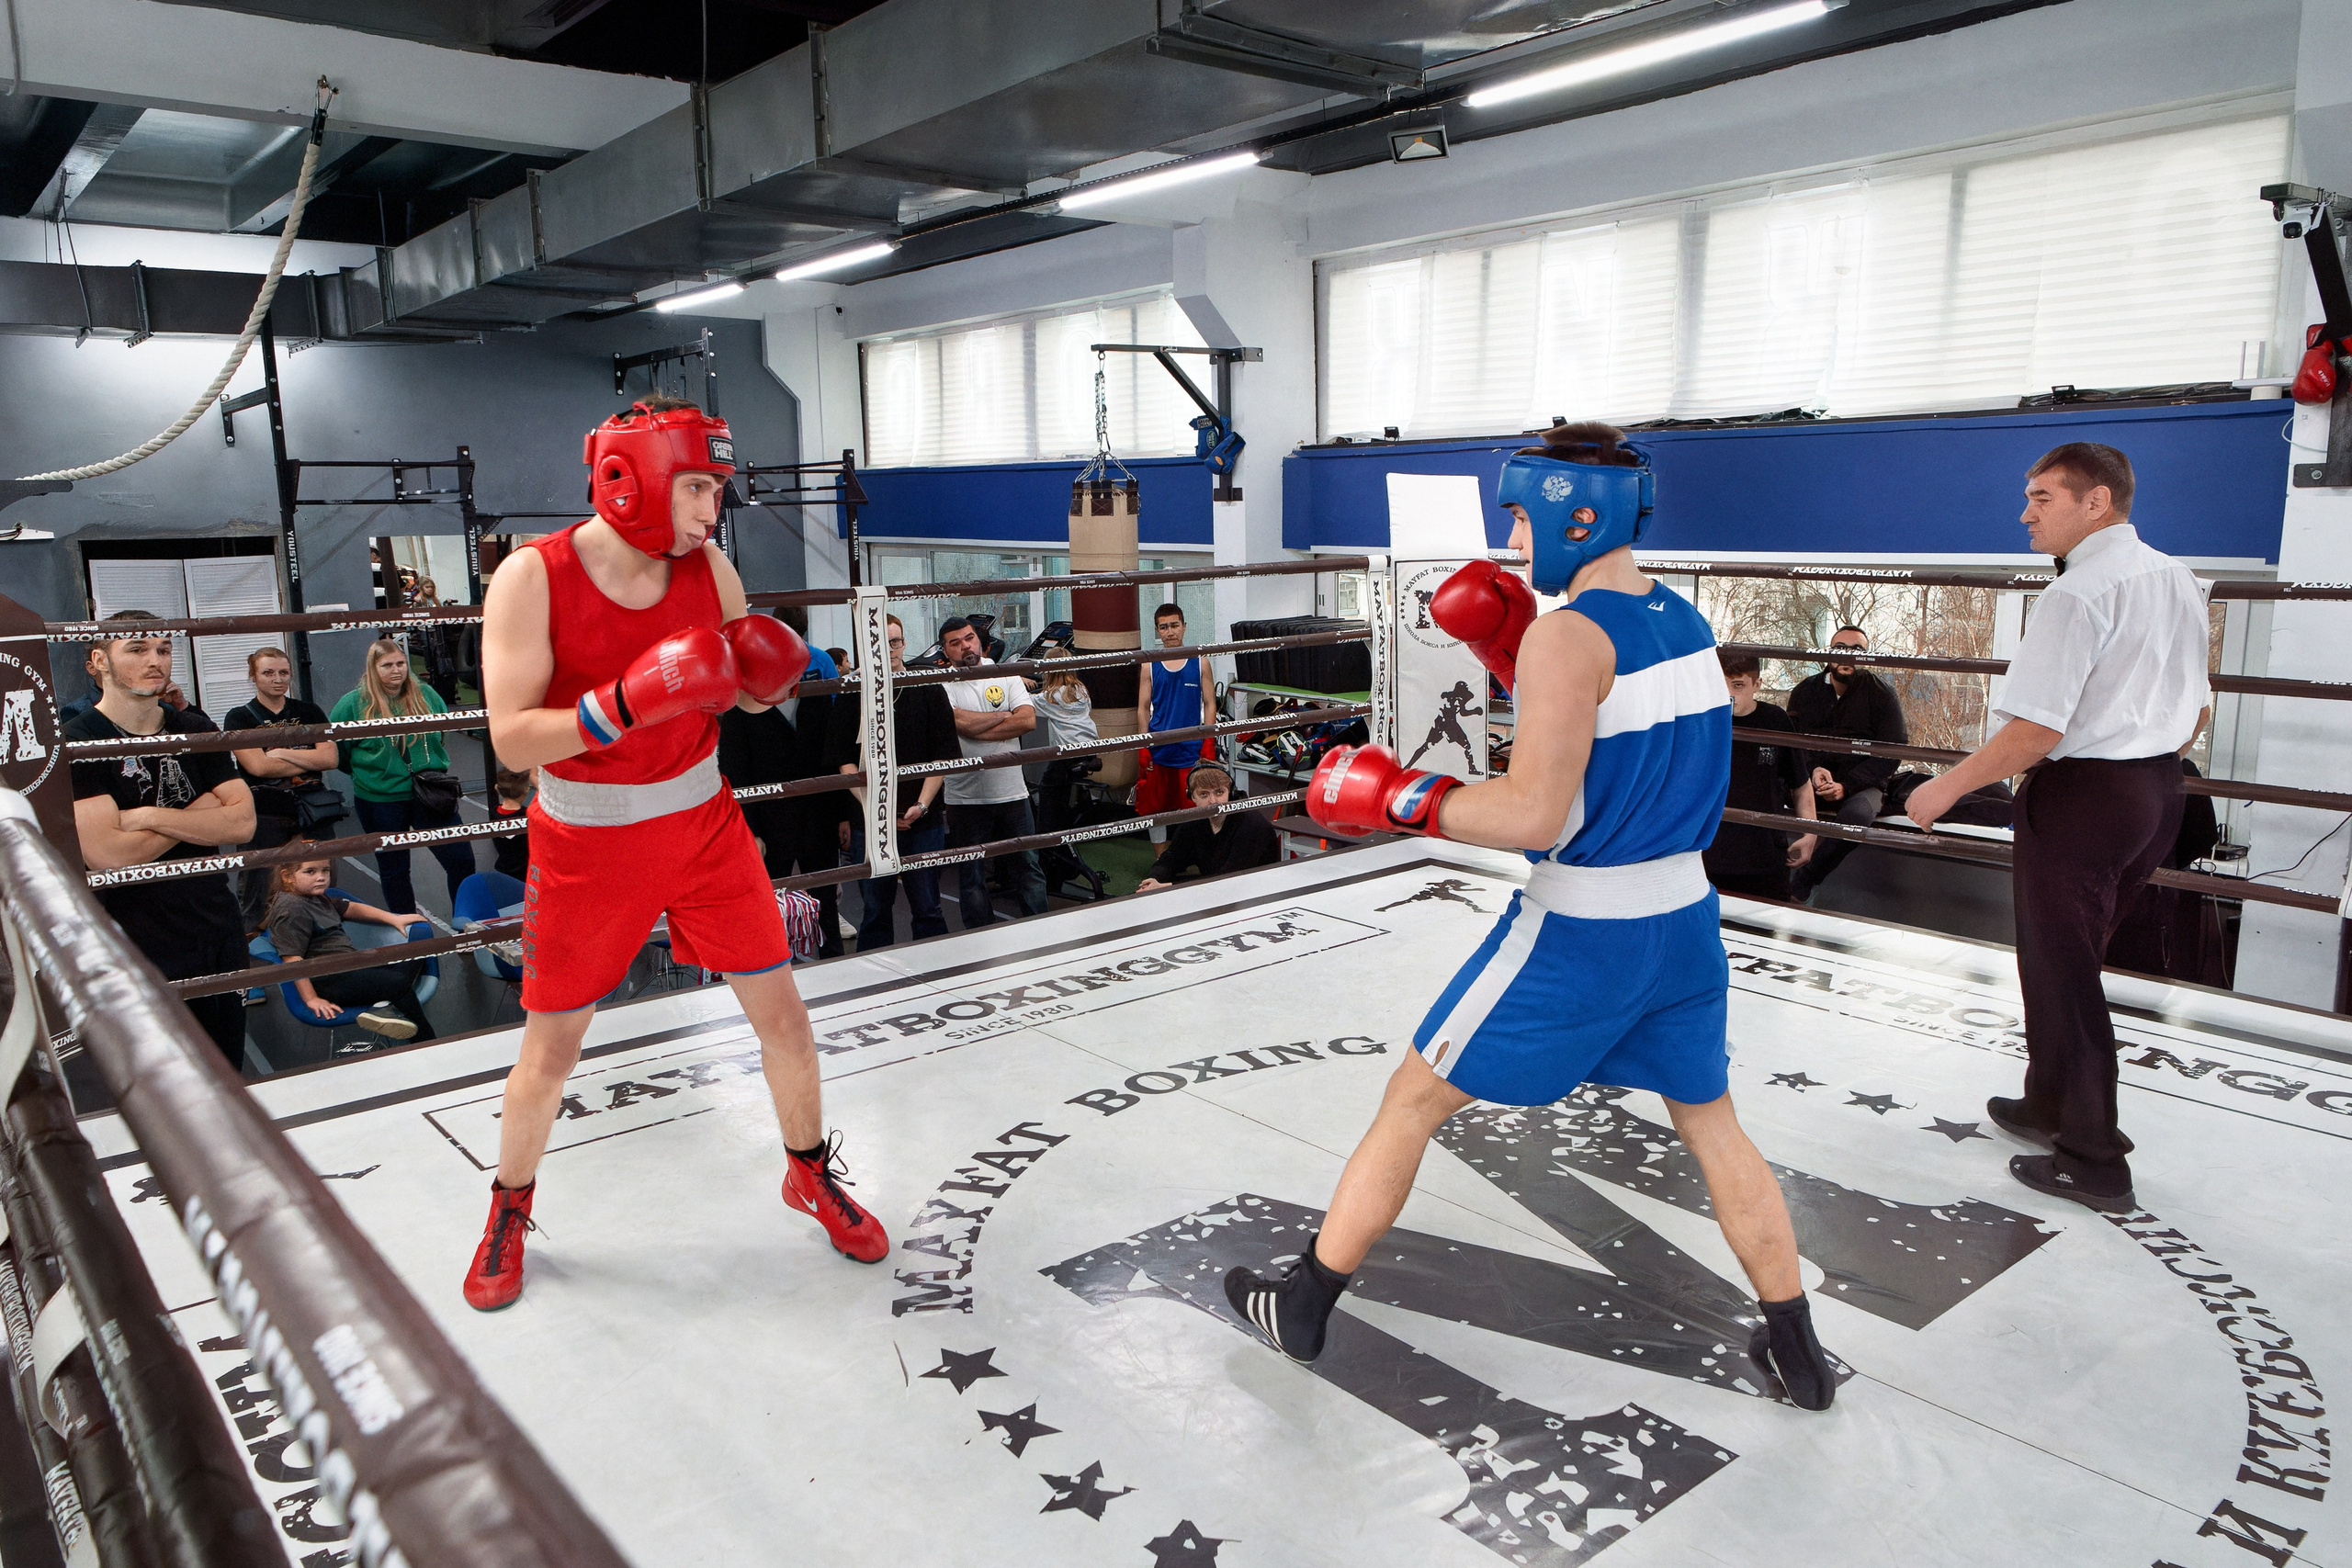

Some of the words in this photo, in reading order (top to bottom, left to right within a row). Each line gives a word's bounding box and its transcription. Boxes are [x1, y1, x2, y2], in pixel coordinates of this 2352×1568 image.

[286, 530, 300, 583] YOUSTEEL
[469, 524, 479, 578] YOUSTEEL
[1404, 569, 1430, 593] MAYFAT
[331, 616, 484, 630] AYFATBOXINGGYM
[23, 664, 48, 693] GYM
[869, 607, 890, 861] MAYFATBOXINGGYM
[1217, 791, 1298, 815] MAYFATBOXINGGYM
[380, 817, 528, 847] AYFATBOXINGGYM
[1060, 818, 1154, 844] MAYFATBOXINGGYM
[1270, 910, 1305, 921] TM
[944, 1016, 1023, 1040] SINCE
[1893, 1014, 1983, 1041] SINCE
[891, 1122, 1071, 1318] MAYFAT
[1064, 1034, 1387, 1117] BOXING
